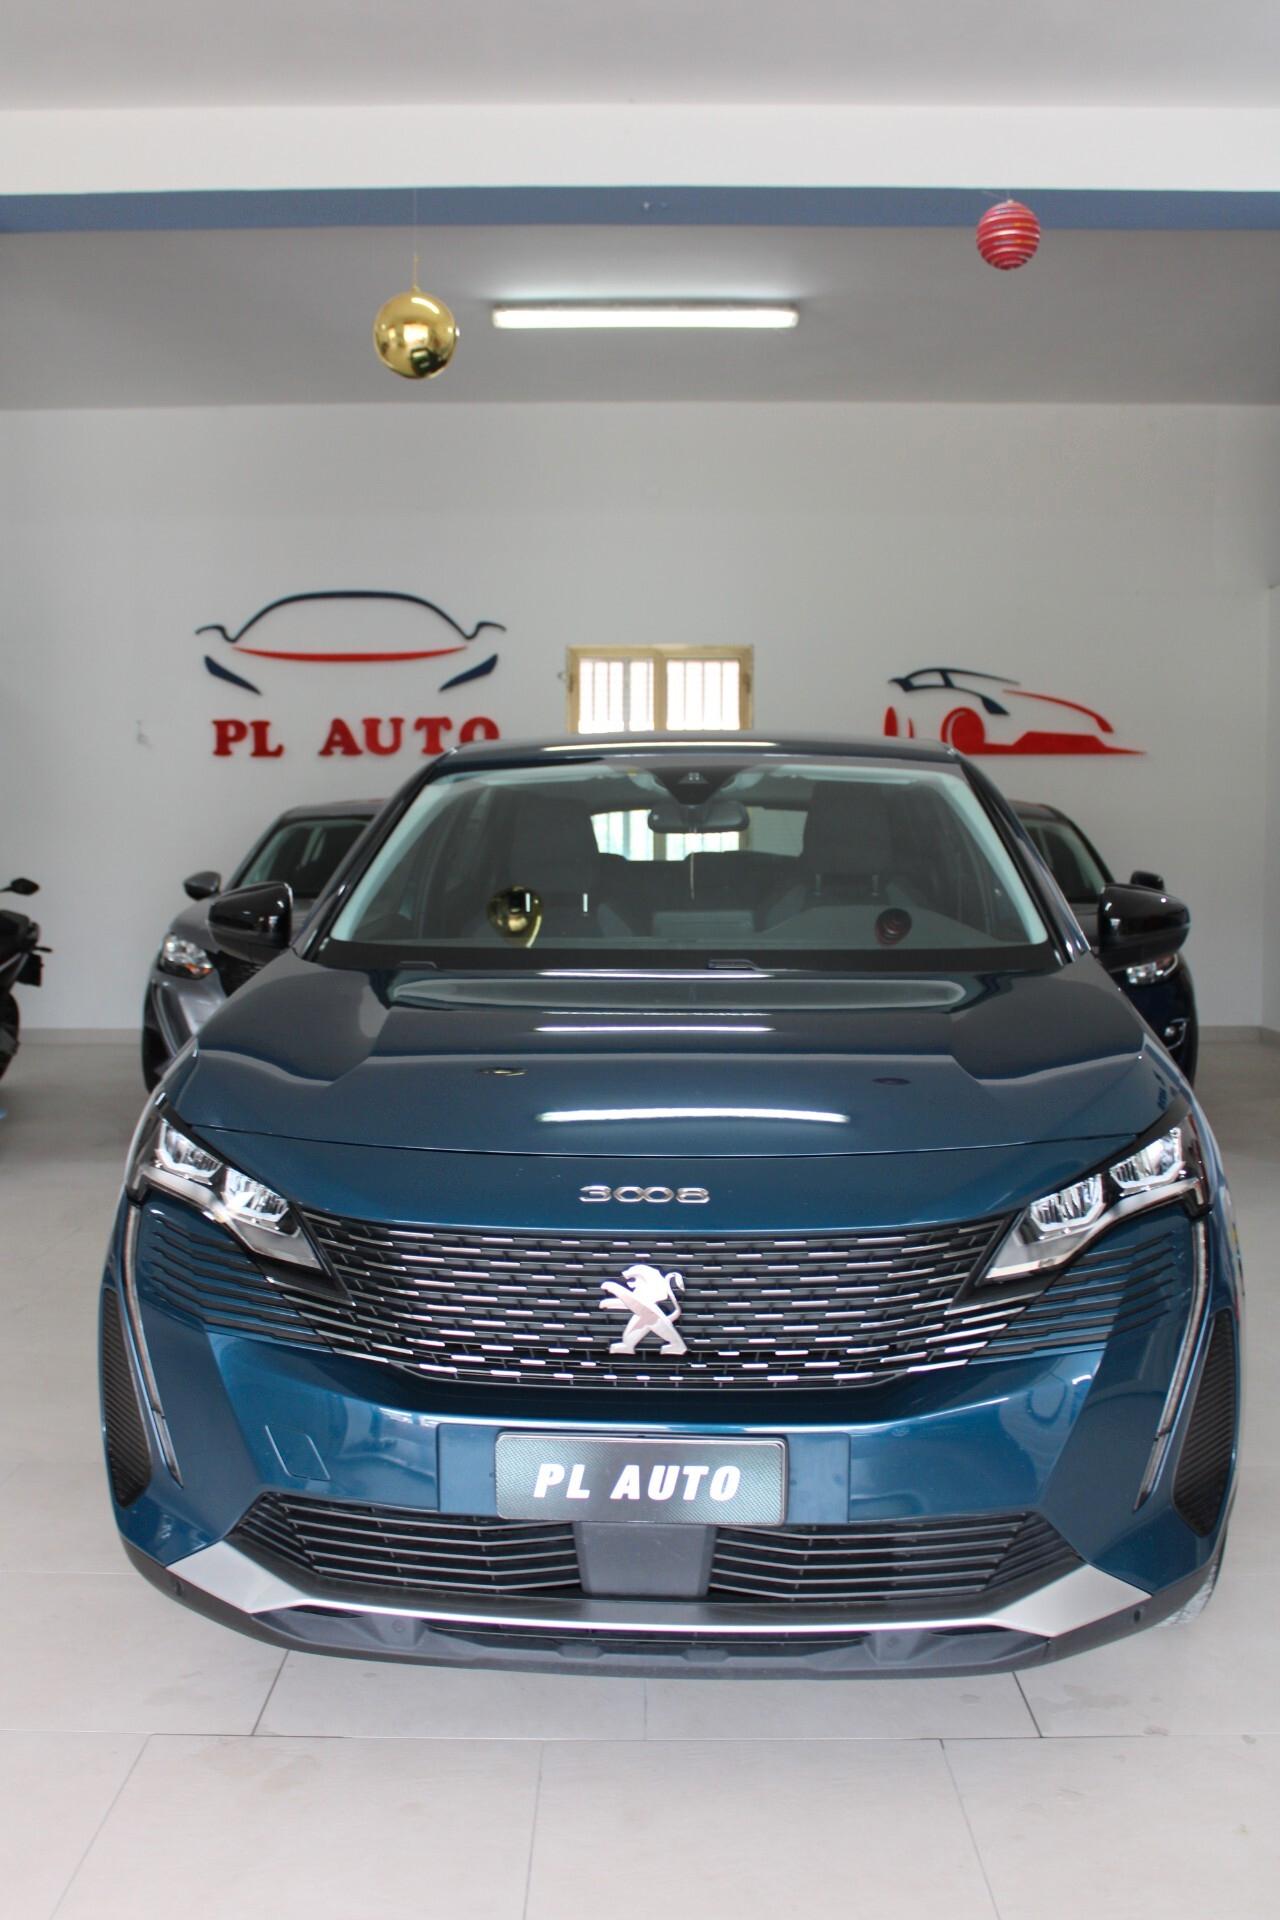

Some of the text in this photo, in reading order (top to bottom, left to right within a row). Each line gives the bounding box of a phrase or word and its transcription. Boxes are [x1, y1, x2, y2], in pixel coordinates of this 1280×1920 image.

[211, 716, 500, 757] PL AUTO
[579, 1185, 710, 1204] 3008
[533, 1463, 741, 1501] PL AUTO
